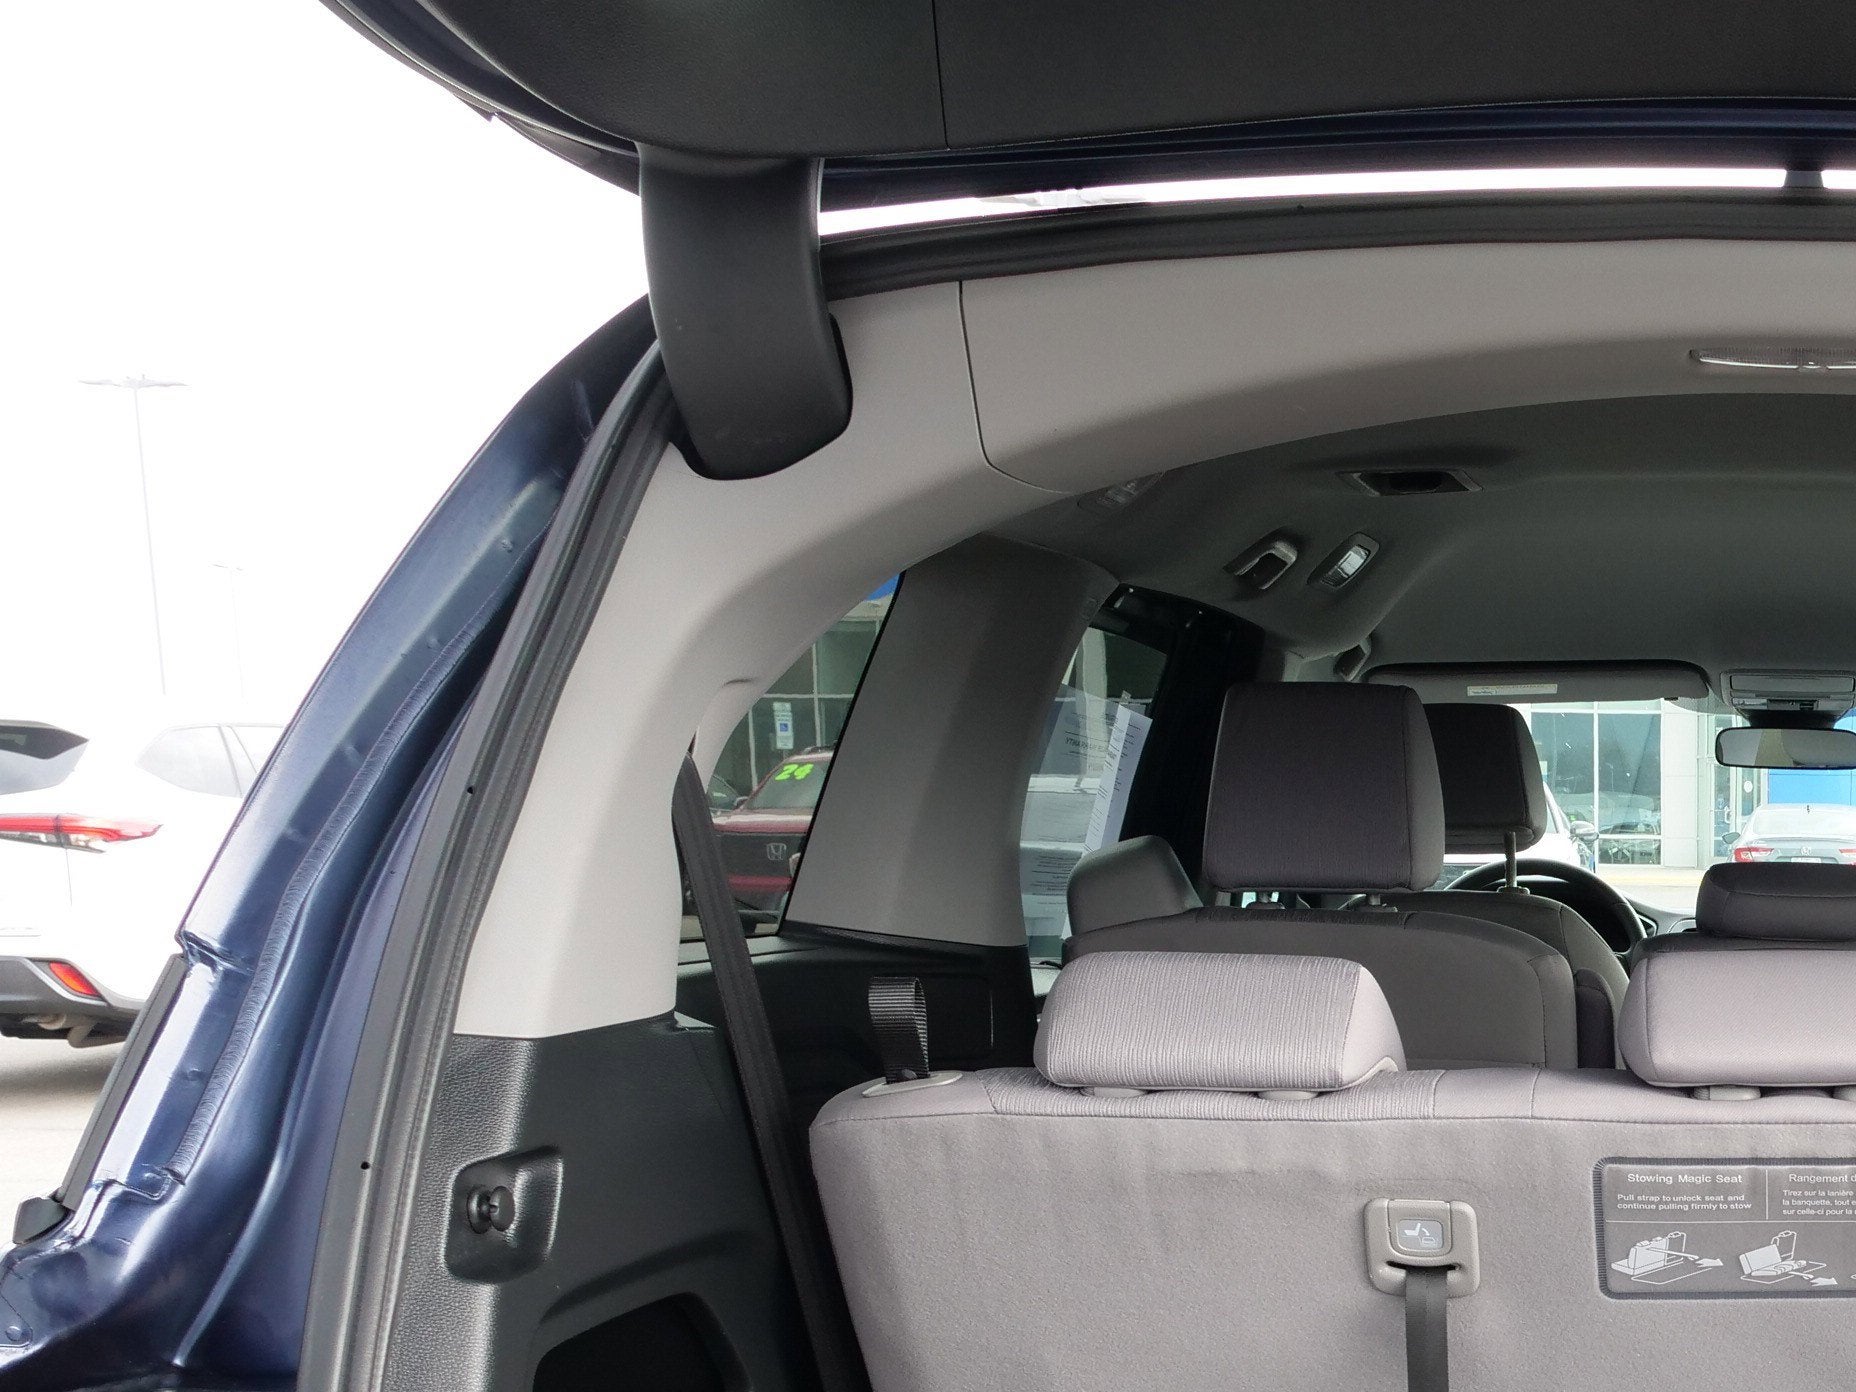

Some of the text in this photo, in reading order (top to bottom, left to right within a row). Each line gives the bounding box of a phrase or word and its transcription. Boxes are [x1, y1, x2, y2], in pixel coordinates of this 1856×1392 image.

[774, 763, 815, 781] 24
[1627, 1173, 1743, 1185] Stowing Magic Seat
[1788, 1173, 1849, 1184] Rangement
[1658, 1202, 1689, 1211] pulling
[1691, 1202, 1717, 1211] firmly
[1791, 1199, 1833, 1207] banquette,
